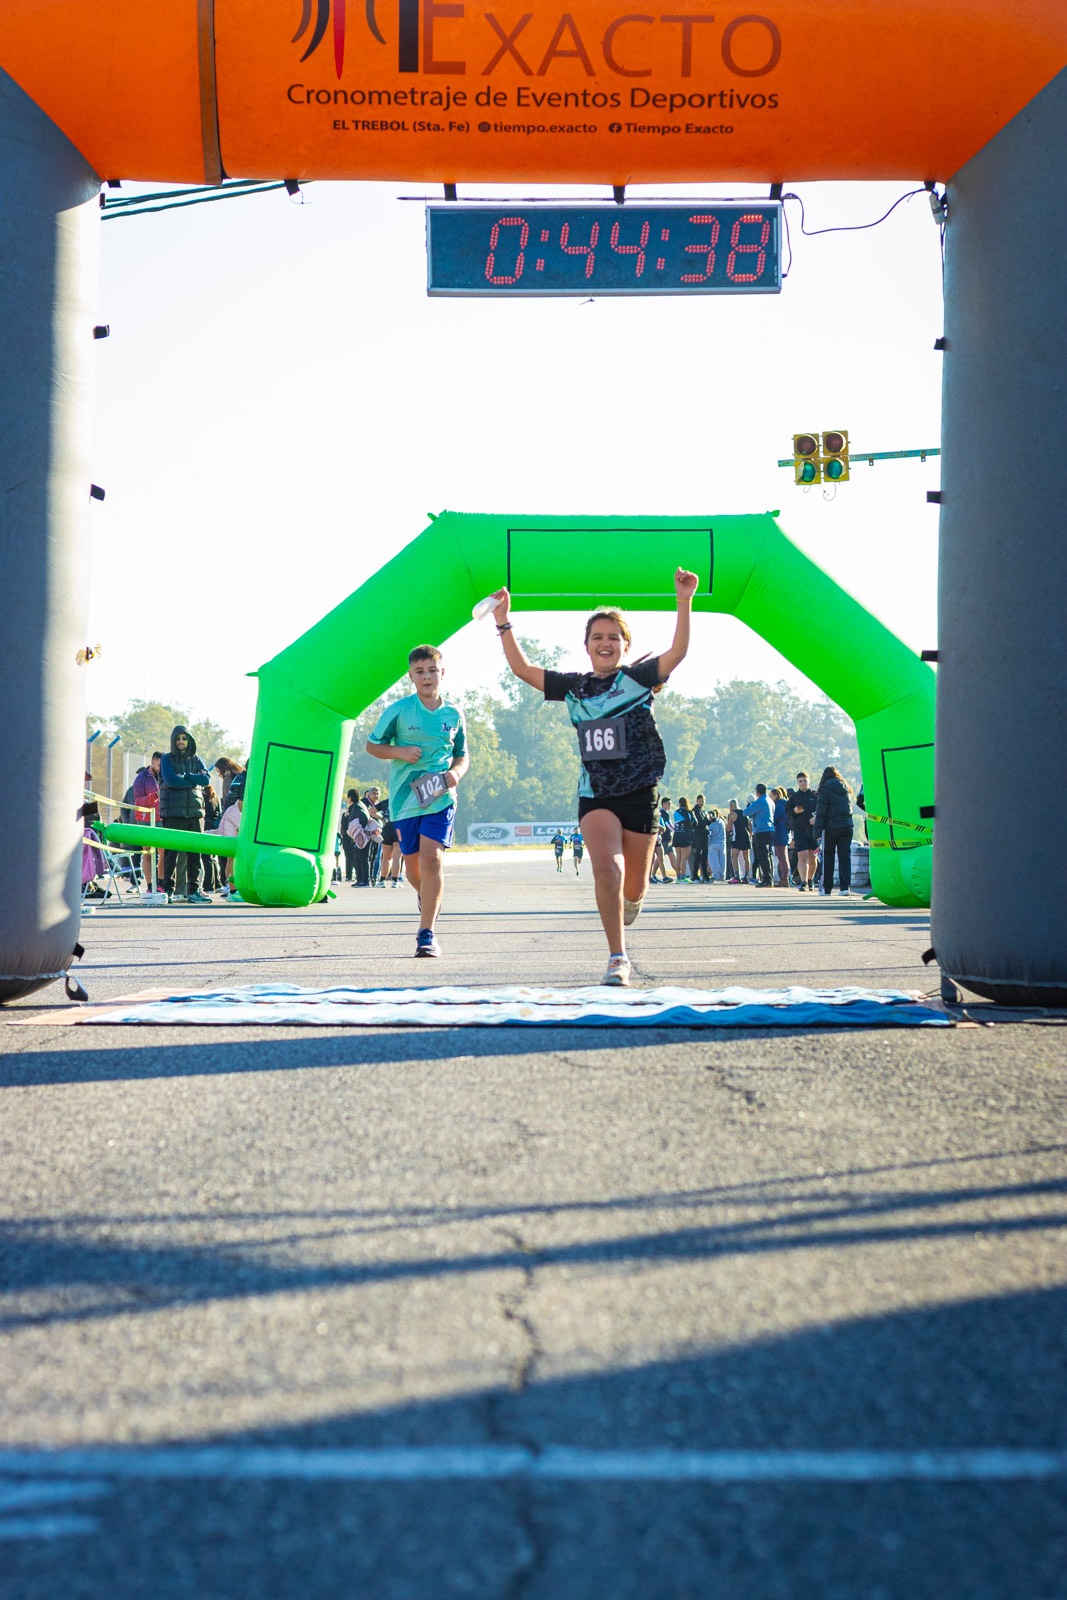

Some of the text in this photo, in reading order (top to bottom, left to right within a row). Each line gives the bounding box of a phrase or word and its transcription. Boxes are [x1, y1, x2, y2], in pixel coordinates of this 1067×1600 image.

[287, 83, 779, 113] Cronometraje de Eventos Deportivos
[333, 120, 734, 135] EL TREBOL (Sta. Fe) tiempo.exacto Tiempo Exacto
[484, 214, 771, 285] 0:44:38
[585, 727, 615, 752] 166
[420, 775, 443, 800] 102
[478, 826, 502, 838] Ford
